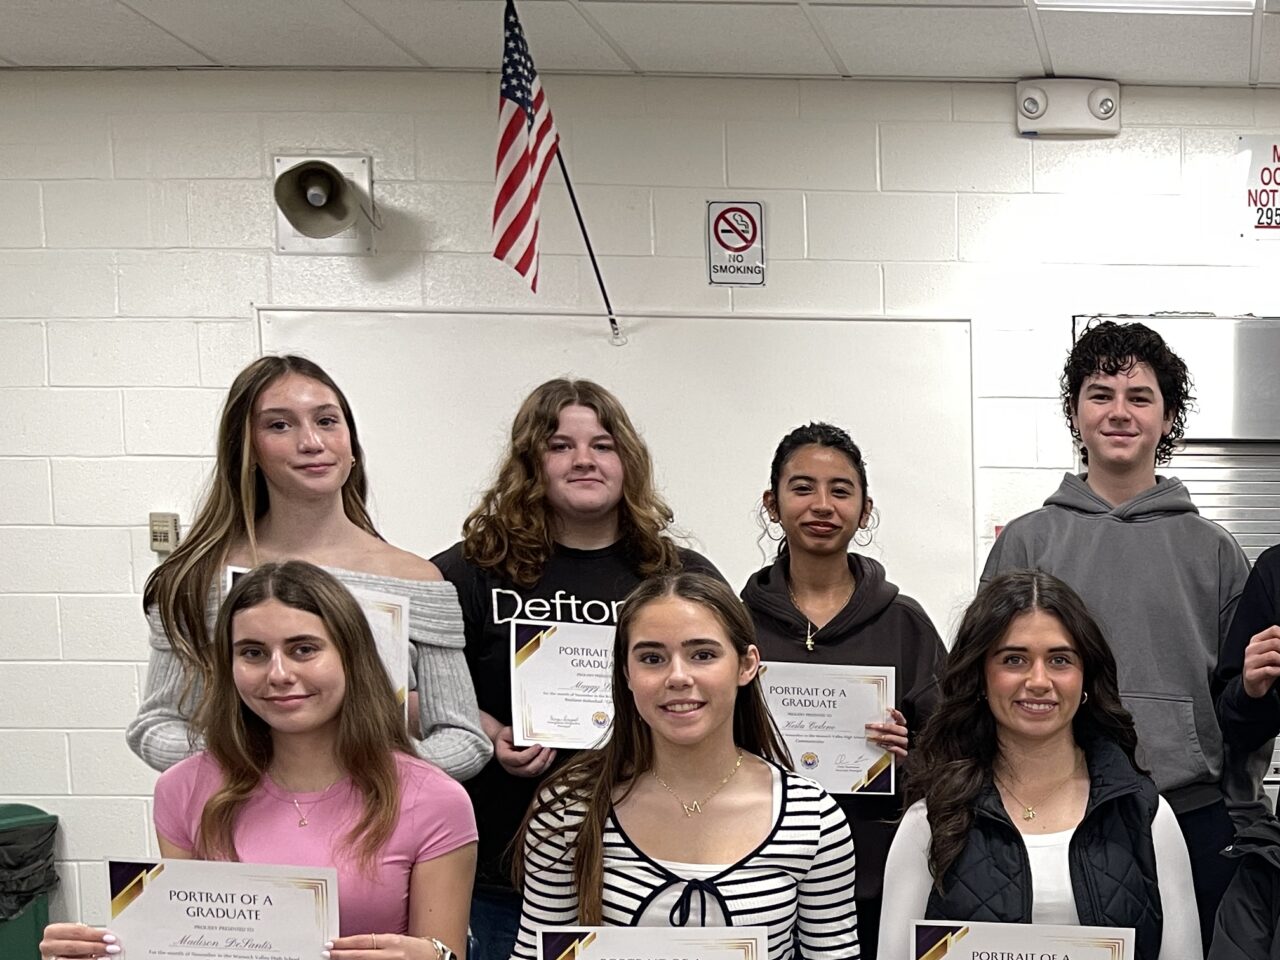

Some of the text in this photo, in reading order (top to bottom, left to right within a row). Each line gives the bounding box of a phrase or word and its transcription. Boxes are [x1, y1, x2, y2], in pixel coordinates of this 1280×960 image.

[1248, 189, 1278, 207] NOT
[728, 254, 744, 263] NO
[712, 264, 761, 275] SMOKING
[491, 588, 626, 624] Defto
[559, 646, 609, 657] PORTRAIT
[571, 658, 614, 669] GRADUA
[769, 686, 847, 697] PORTRAIT OF A
[781, 698, 838, 708] GRADUATE
[169, 890, 273, 906] PORTRAIT OF A
[186, 906, 260, 920] GRADUATE
[176, 934, 219, 947] Madison
